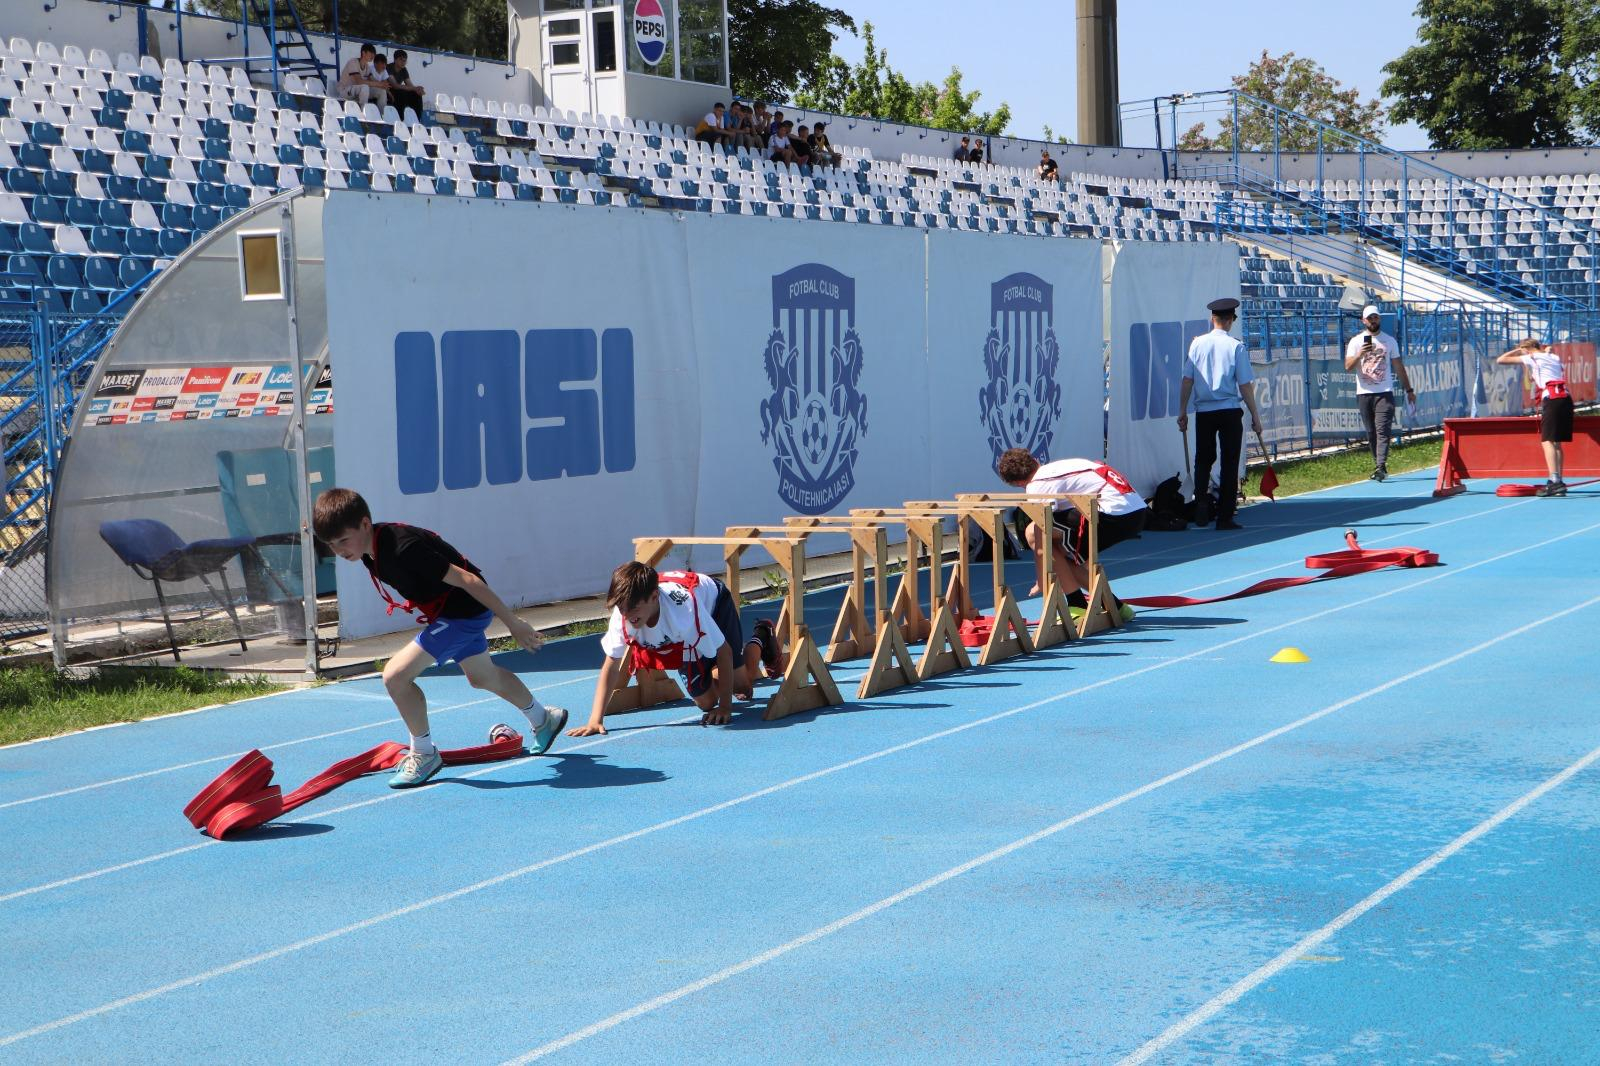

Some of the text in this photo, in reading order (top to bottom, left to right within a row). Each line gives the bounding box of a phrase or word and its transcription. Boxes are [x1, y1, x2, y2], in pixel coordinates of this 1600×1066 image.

[635, 19, 665, 38] PEPSI
[789, 279, 840, 299] FOTBAL CLUB
[1003, 285, 1042, 303] FOTBAL CLUB
[99, 374, 140, 389] MAXBET
[142, 375, 185, 387] PRODALCOM
[1107, 470, 1125, 486] 8
[781, 471, 851, 507] POLITEHNICA IASI
